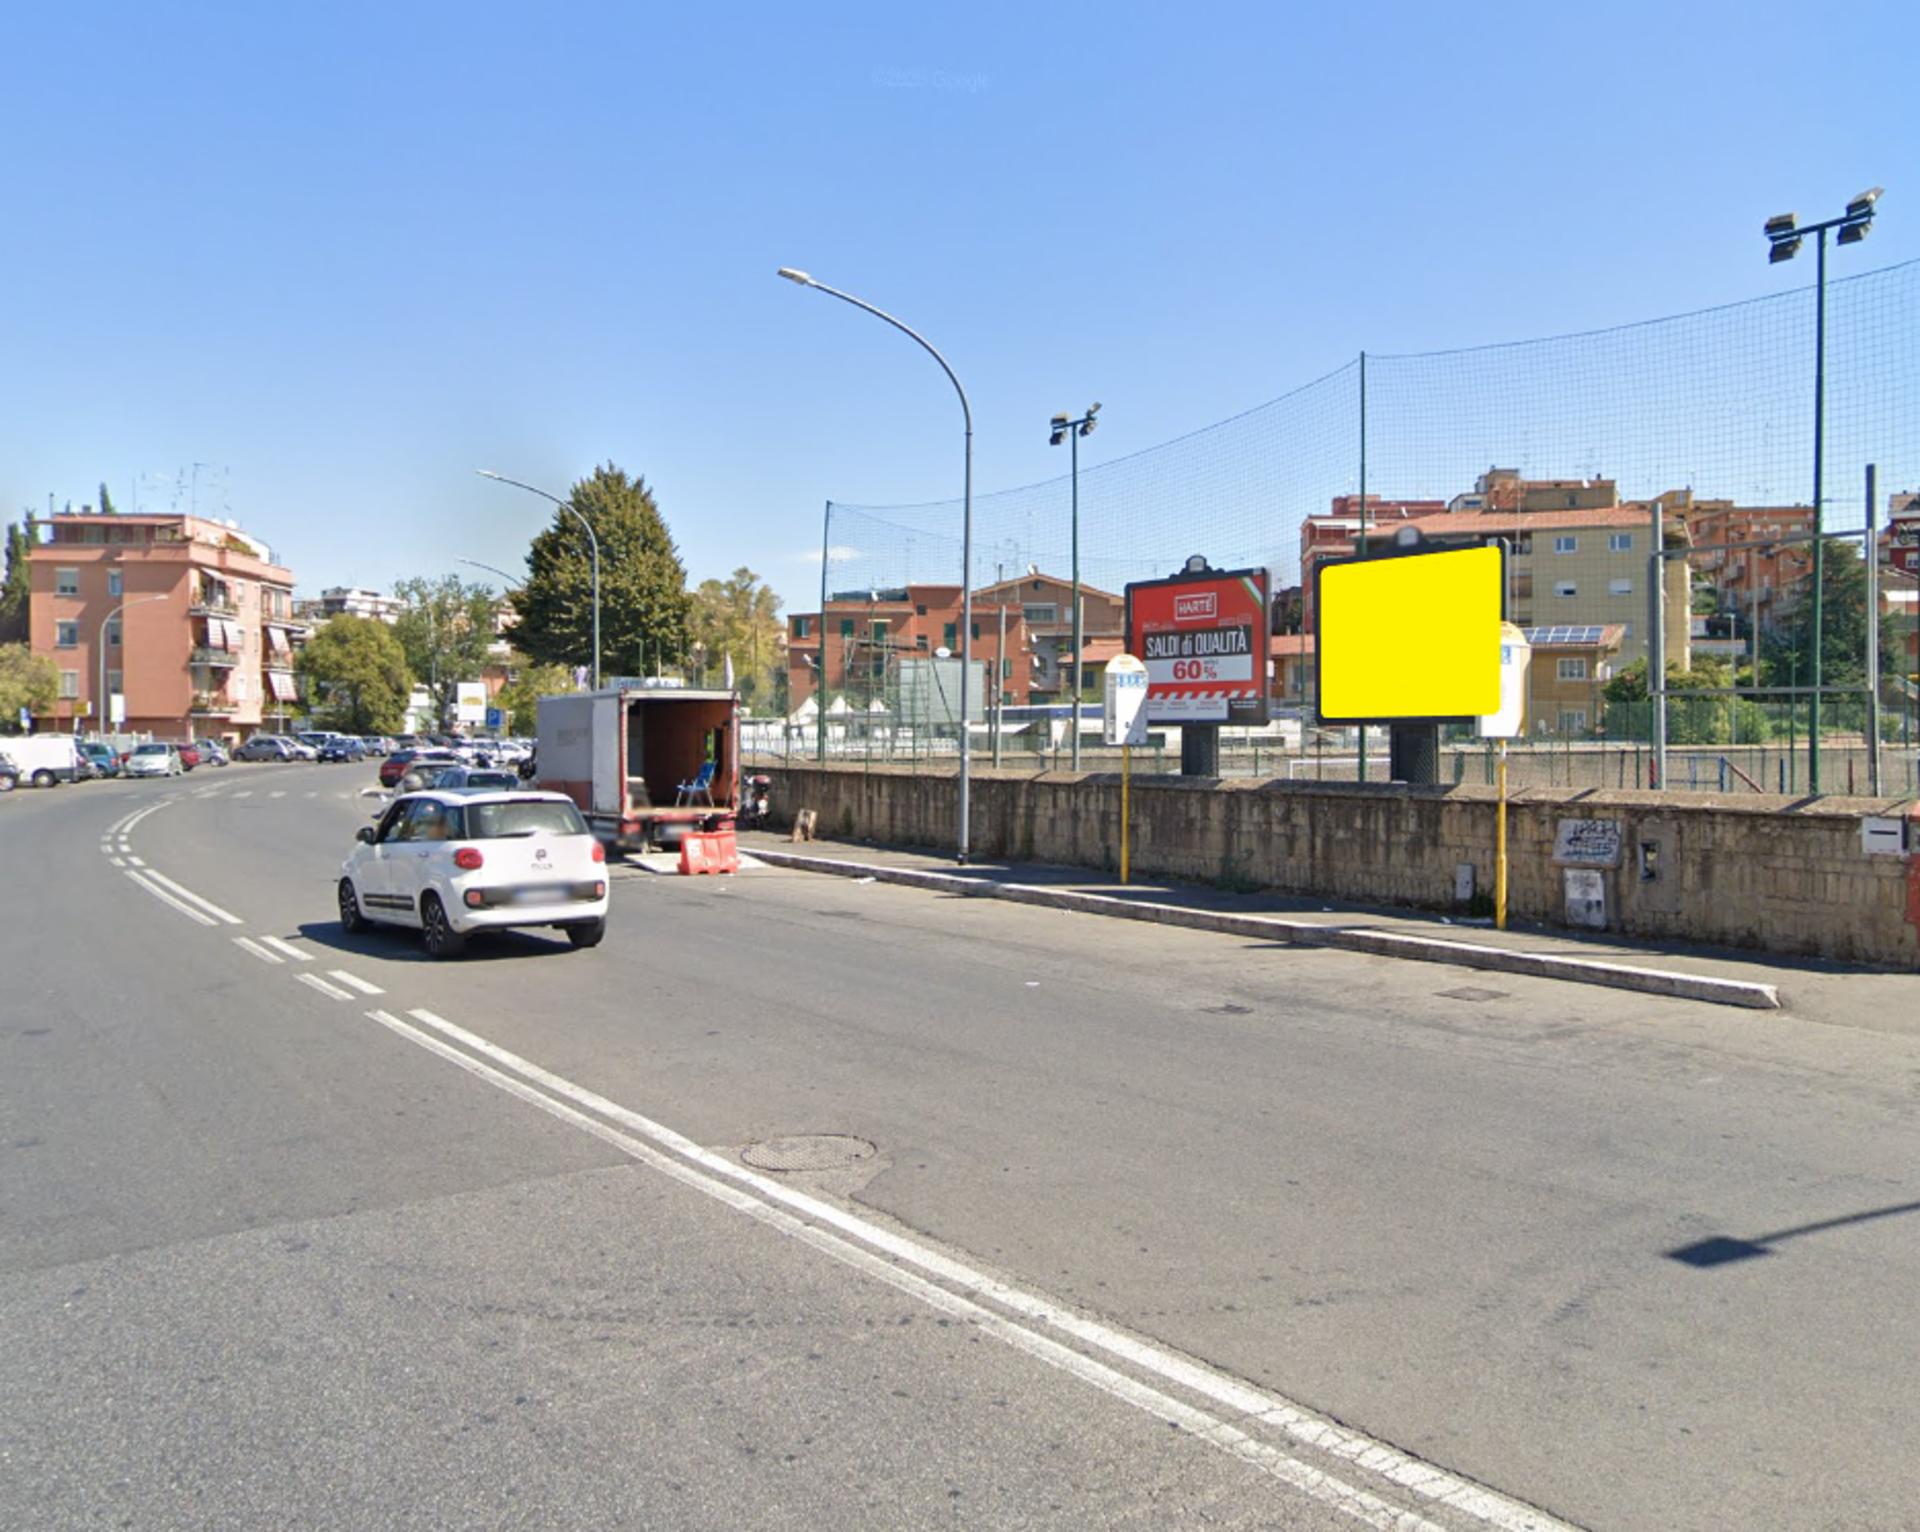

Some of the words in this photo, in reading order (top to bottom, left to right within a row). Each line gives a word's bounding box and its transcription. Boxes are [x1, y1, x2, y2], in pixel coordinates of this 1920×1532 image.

[1146, 636, 1180, 657] SALDI
[1181, 635, 1193, 655] di
[1195, 627, 1247, 655] QUALITÀ
